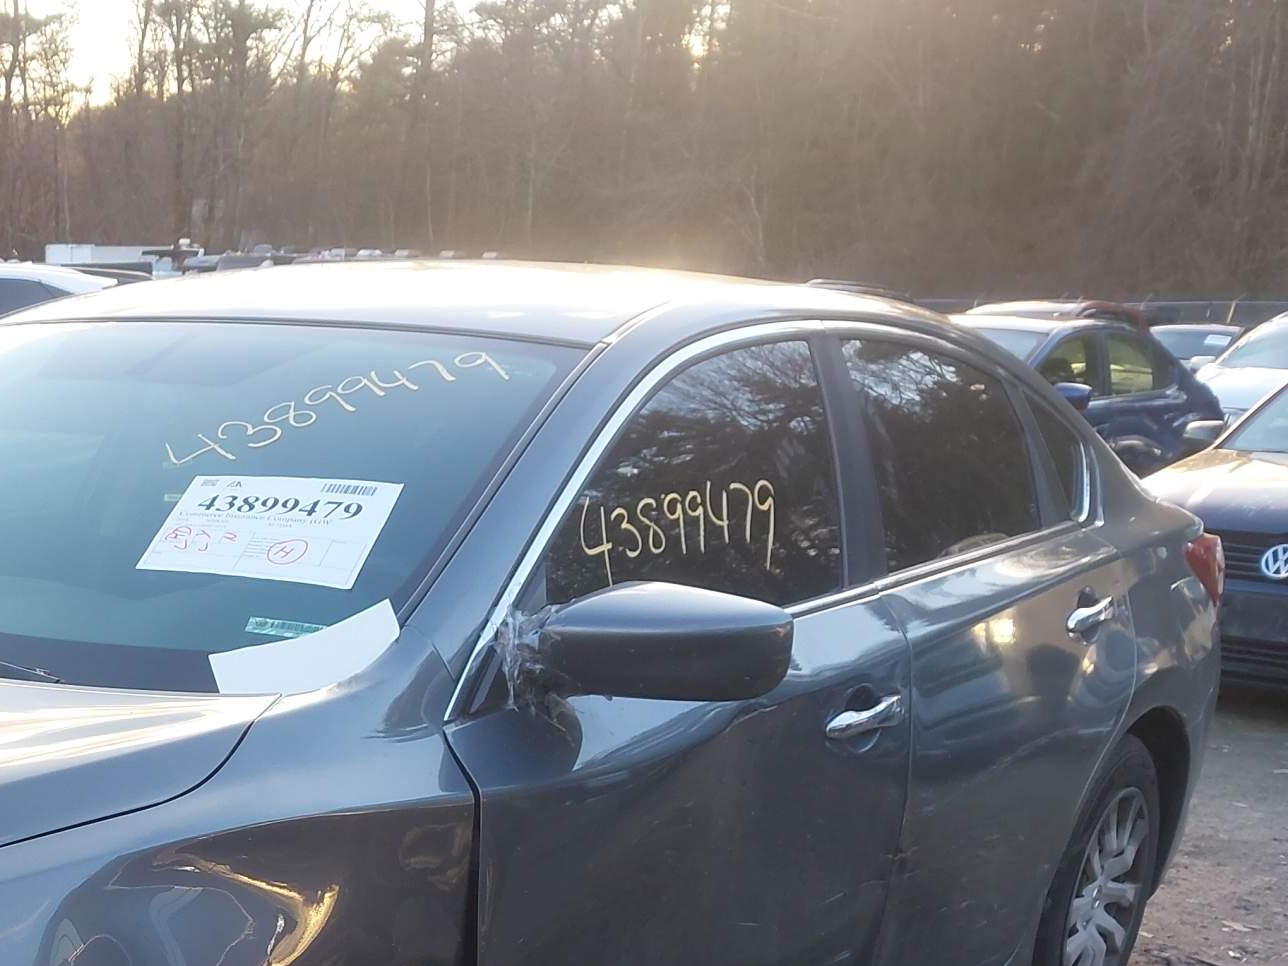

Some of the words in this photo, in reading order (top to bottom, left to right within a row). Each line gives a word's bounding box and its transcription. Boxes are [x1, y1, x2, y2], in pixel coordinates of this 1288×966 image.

[164, 350, 511, 465] 43899479
[198, 494, 363, 521] 43899479
[579, 479, 775, 587] 43899479
